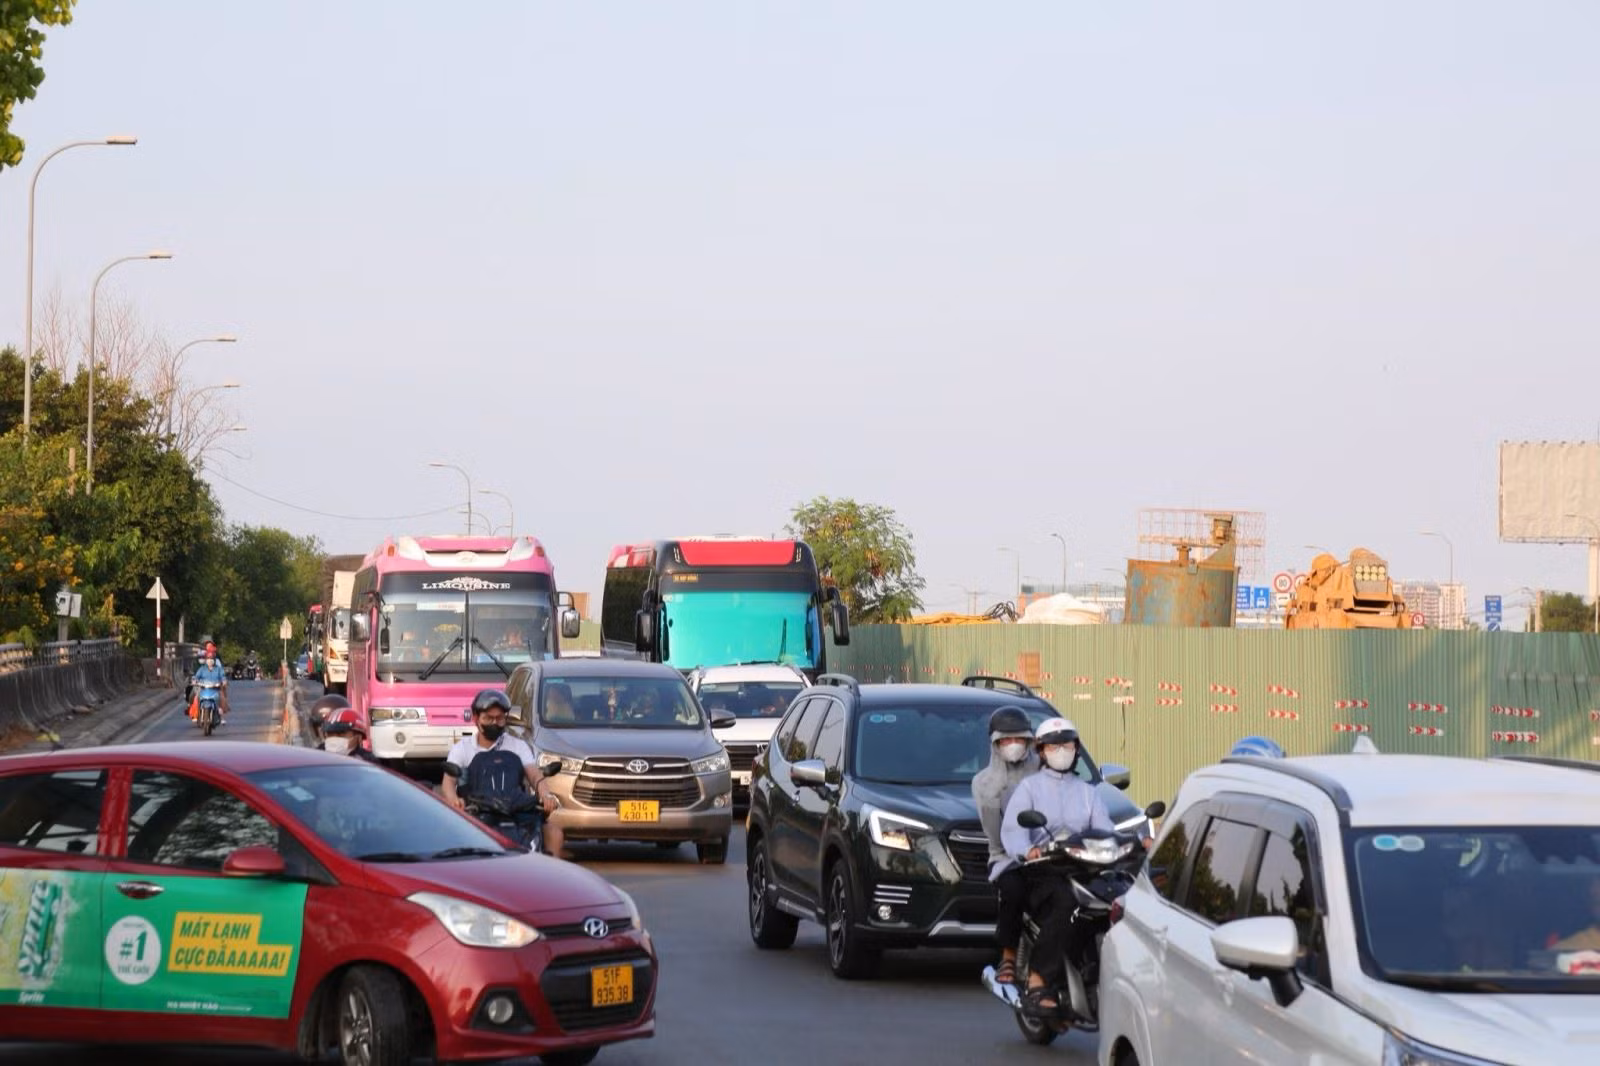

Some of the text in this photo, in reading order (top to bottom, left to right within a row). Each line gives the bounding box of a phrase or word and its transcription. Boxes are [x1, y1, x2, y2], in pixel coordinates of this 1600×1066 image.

[422, 582, 511, 591] LIMOUSINE
[623, 811, 654, 821] 430.11
[630, 801, 648, 812] 51G
[179, 916, 251, 943] MÁT LẠNH
[119, 930, 147, 961] #1
[174, 945, 205, 970] CỰC
[603, 968, 621, 986] 51F
[596, 985, 629, 1005] 935.38
